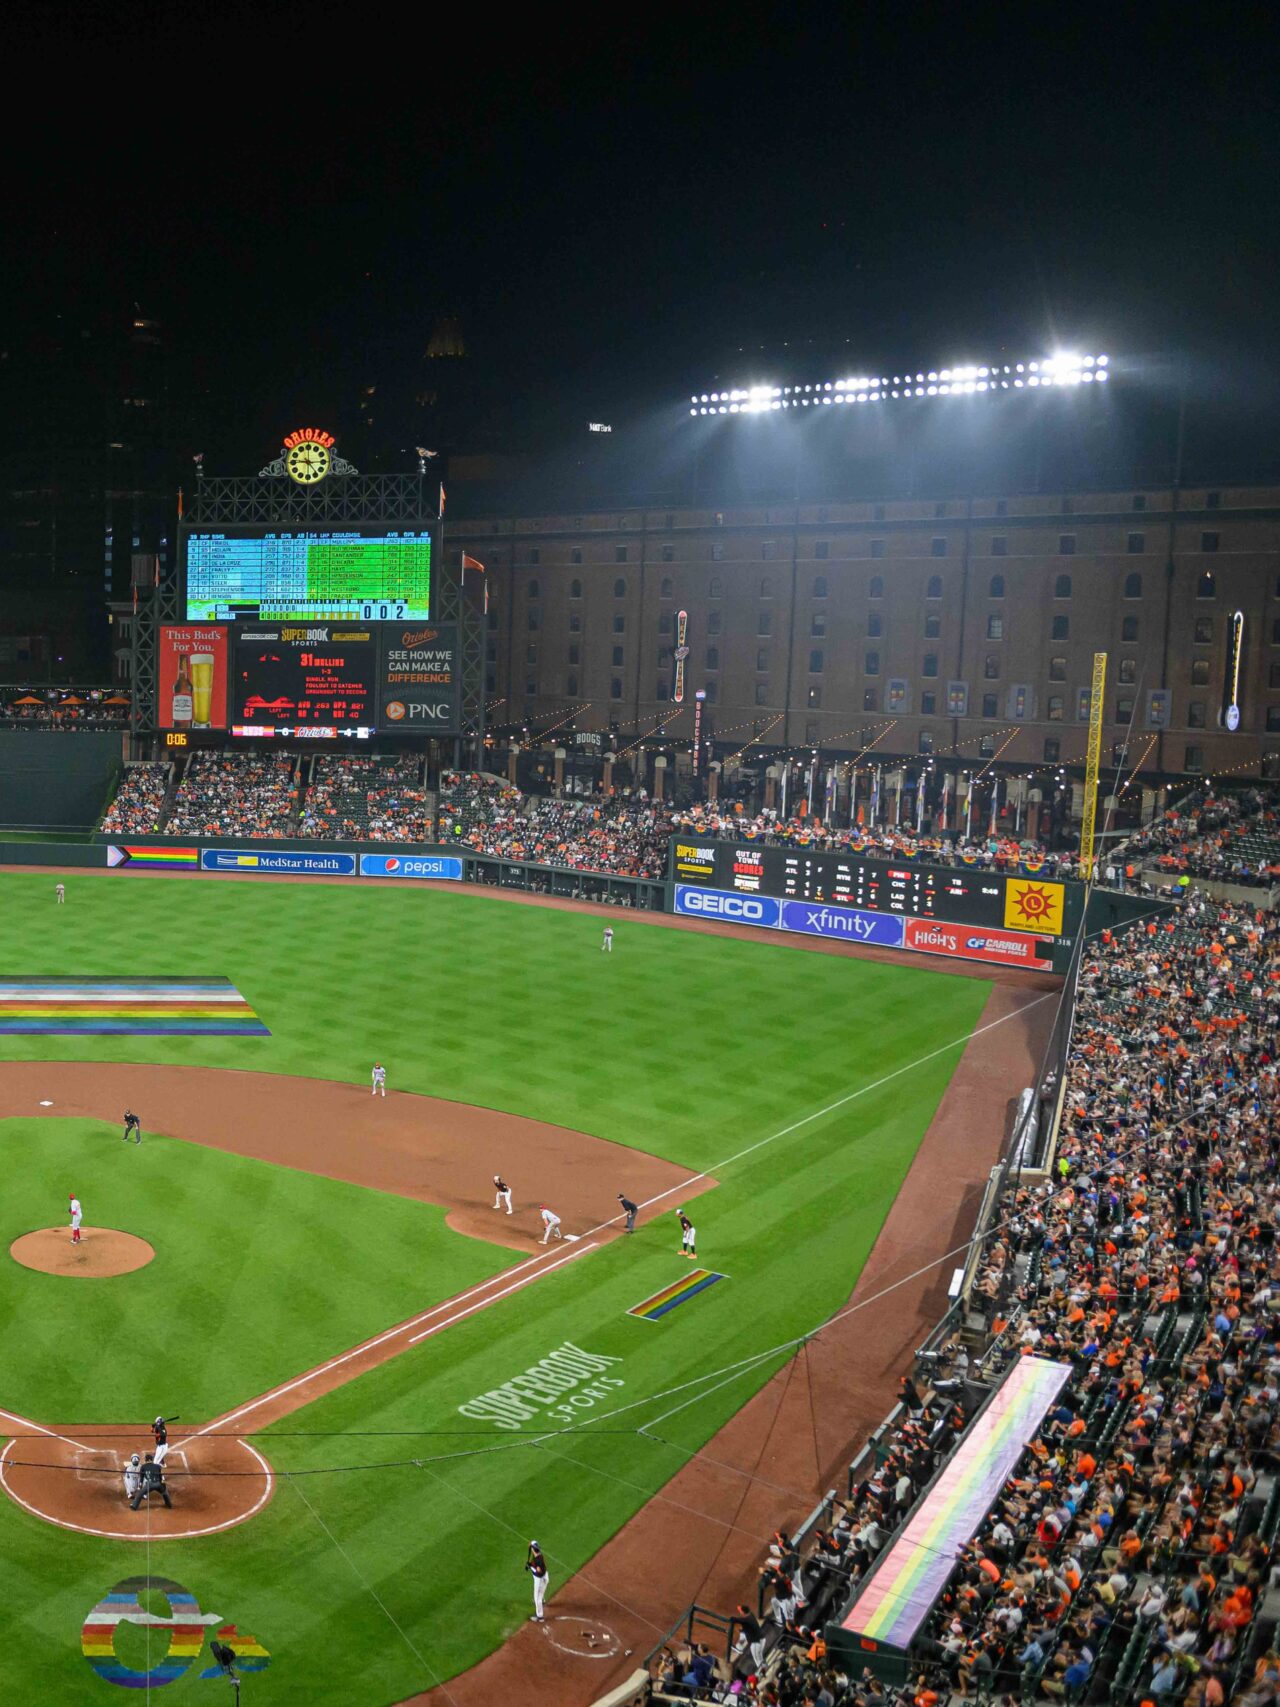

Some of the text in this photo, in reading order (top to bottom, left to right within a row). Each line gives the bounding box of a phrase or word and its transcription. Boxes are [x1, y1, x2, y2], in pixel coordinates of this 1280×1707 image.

[284, 428, 336, 449] ORIOLES
[364, 605, 404, 619] 0 0 2
[167, 630, 221, 640] This Bud's
[281, 628, 329, 642] SUPERBOOK
[401, 629, 439, 649] Orioles
[173, 642, 215, 651] For You.
[300, 653, 313, 667] 31
[388, 651, 453, 660] SEE HOW WE
[388, 662, 451, 671] CAN MAKE A
[388, 673, 452, 683] DIFFERENCE
[243, 708, 255, 718] CF
[408, 703, 451, 719] PNC
[167, 734, 186, 745] 0:06
[676, 844, 715, 862] SUPERBOOK
[735, 850, 750, 858] OUT
[260, 857, 339, 869] MedStar Health
[738, 856, 759, 865] TOWN
[404, 860, 443, 875] pepsi
[733, 863, 764, 876] SCORES
[785, 867, 798, 875] ATL
[684, 891, 763, 919] GEICO
[890, 902, 904, 910] COL
[806, 909, 877, 939] xfinity
[1010, 921, 1033, 929] MARYLAND
[914, 930, 957, 951] HIGH'S
[985, 940, 1028, 953] CARROLL
[1057, 939, 1071, 947] 318
[457, 1341, 624, 1430] SUPERBOOK
[547, 1376, 625, 1422] SPORTS
